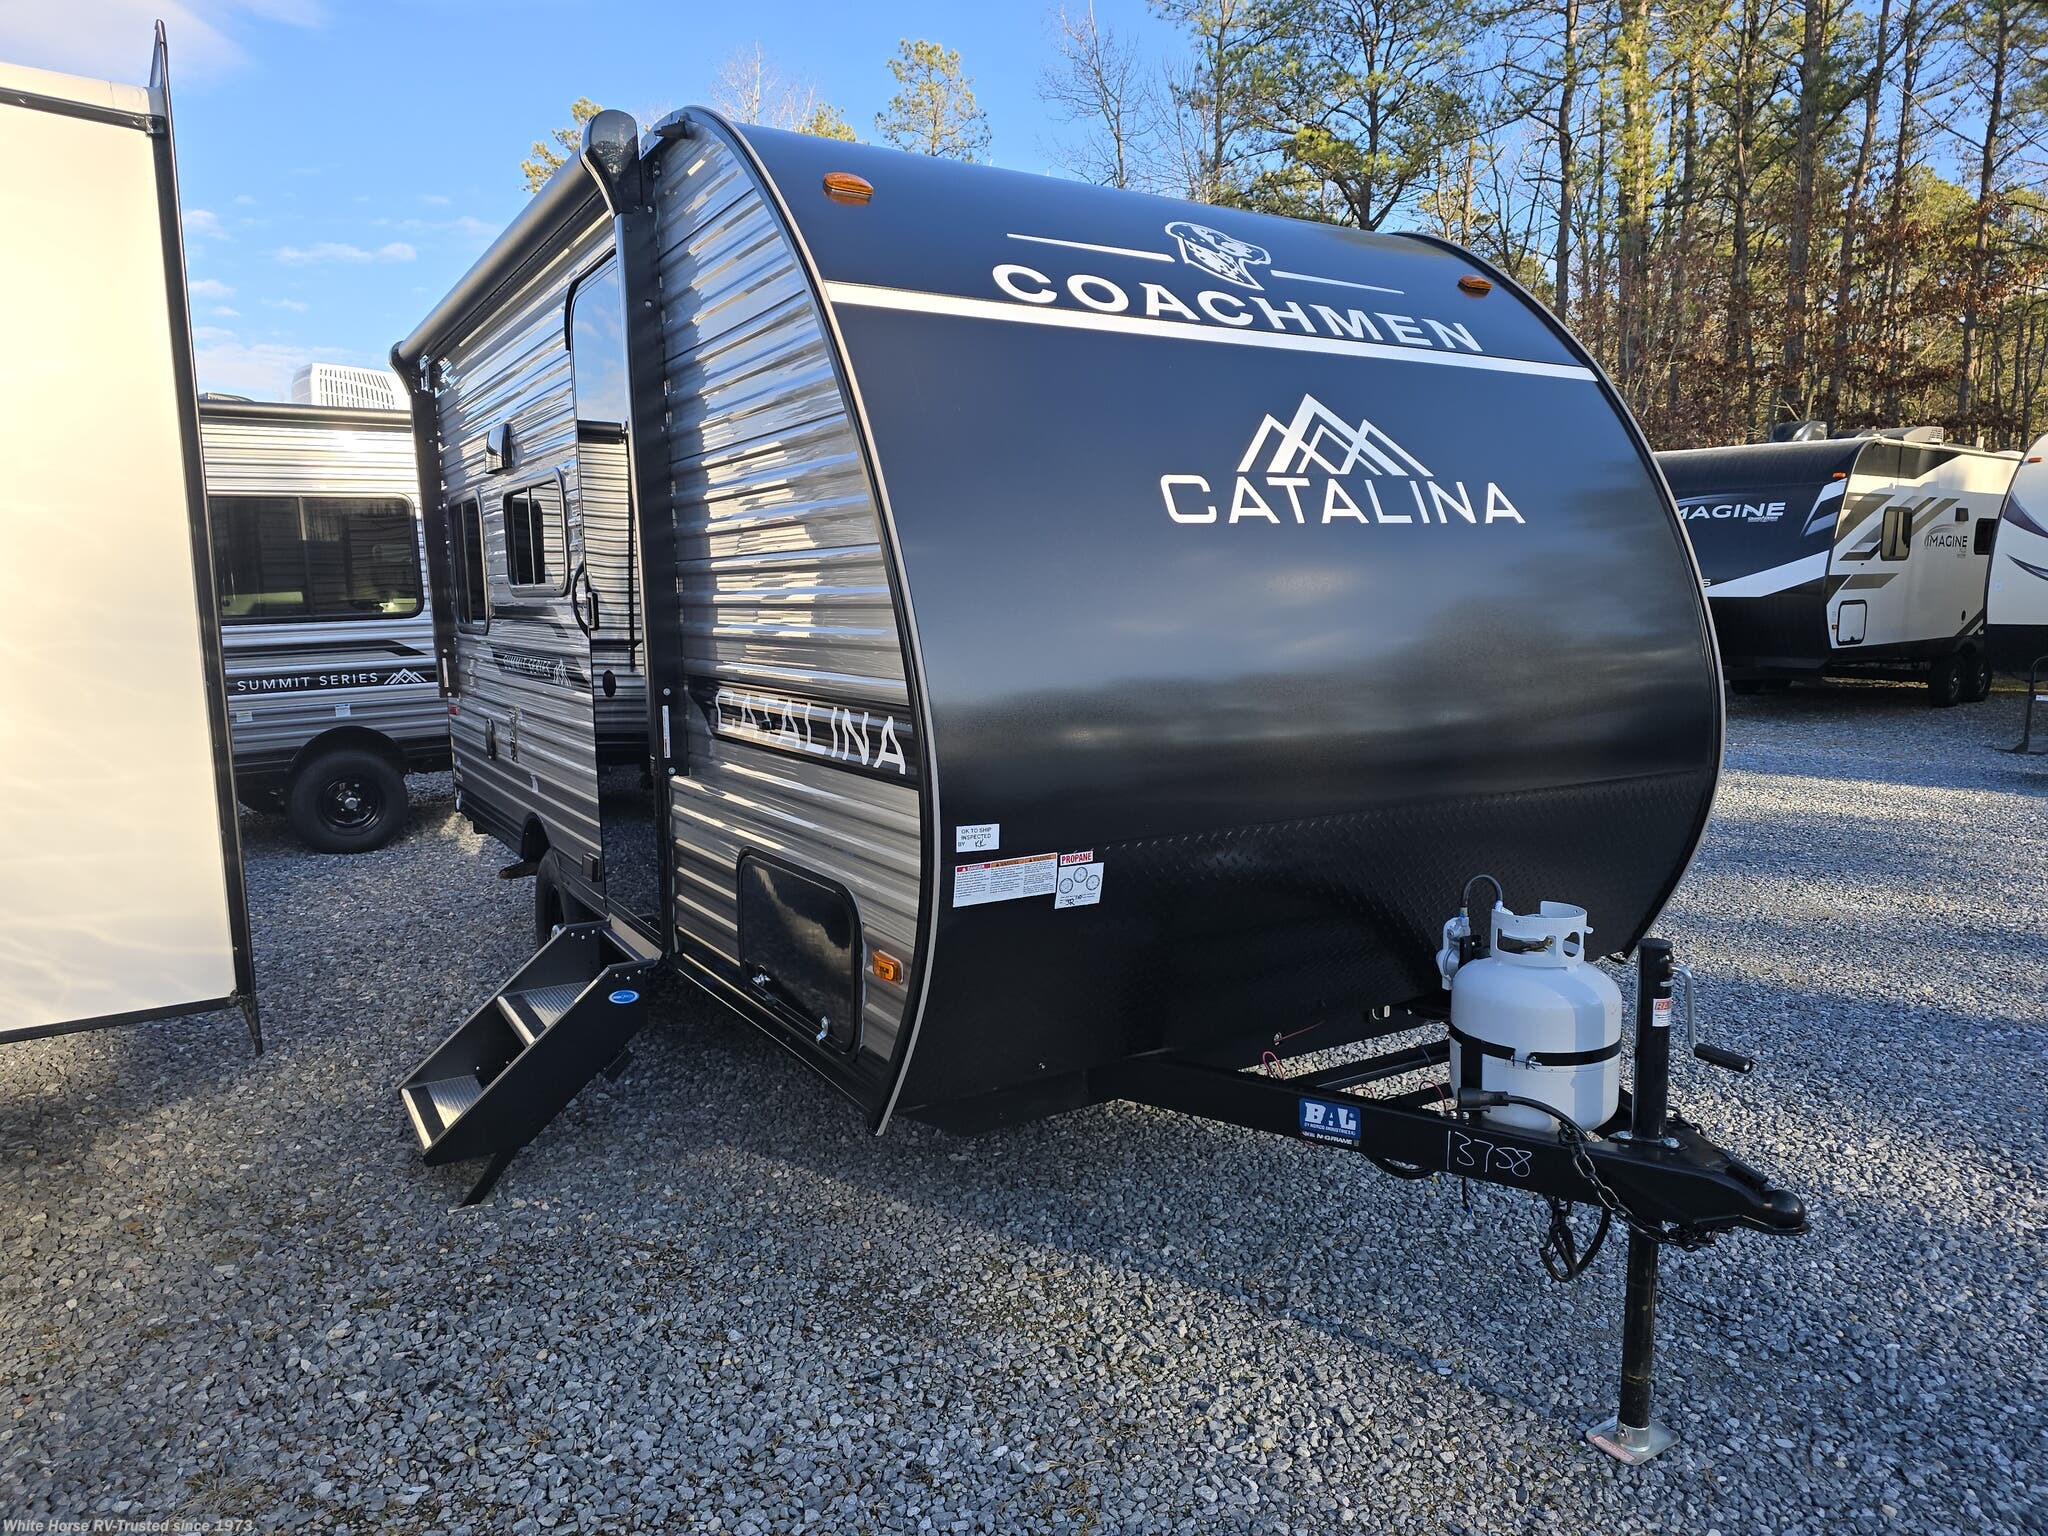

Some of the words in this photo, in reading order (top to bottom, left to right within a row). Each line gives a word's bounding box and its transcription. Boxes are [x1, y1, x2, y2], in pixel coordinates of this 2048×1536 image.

[992, 263, 1484, 352] COACHMEN
[1159, 474, 1526, 524] CATALINA
[1679, 502, 1786, 520] MAGINE
[1926, 534, 1968, 548] IMAGINE
[237, 677, 310, 691] SUMMIT
[319, 672, 378, 686] SERIES
[715, 688, 906, 775] CATALINA
[961, 833, 991, 841] INSPECTED
[1061, 852, 1093, 864] PROPANE
